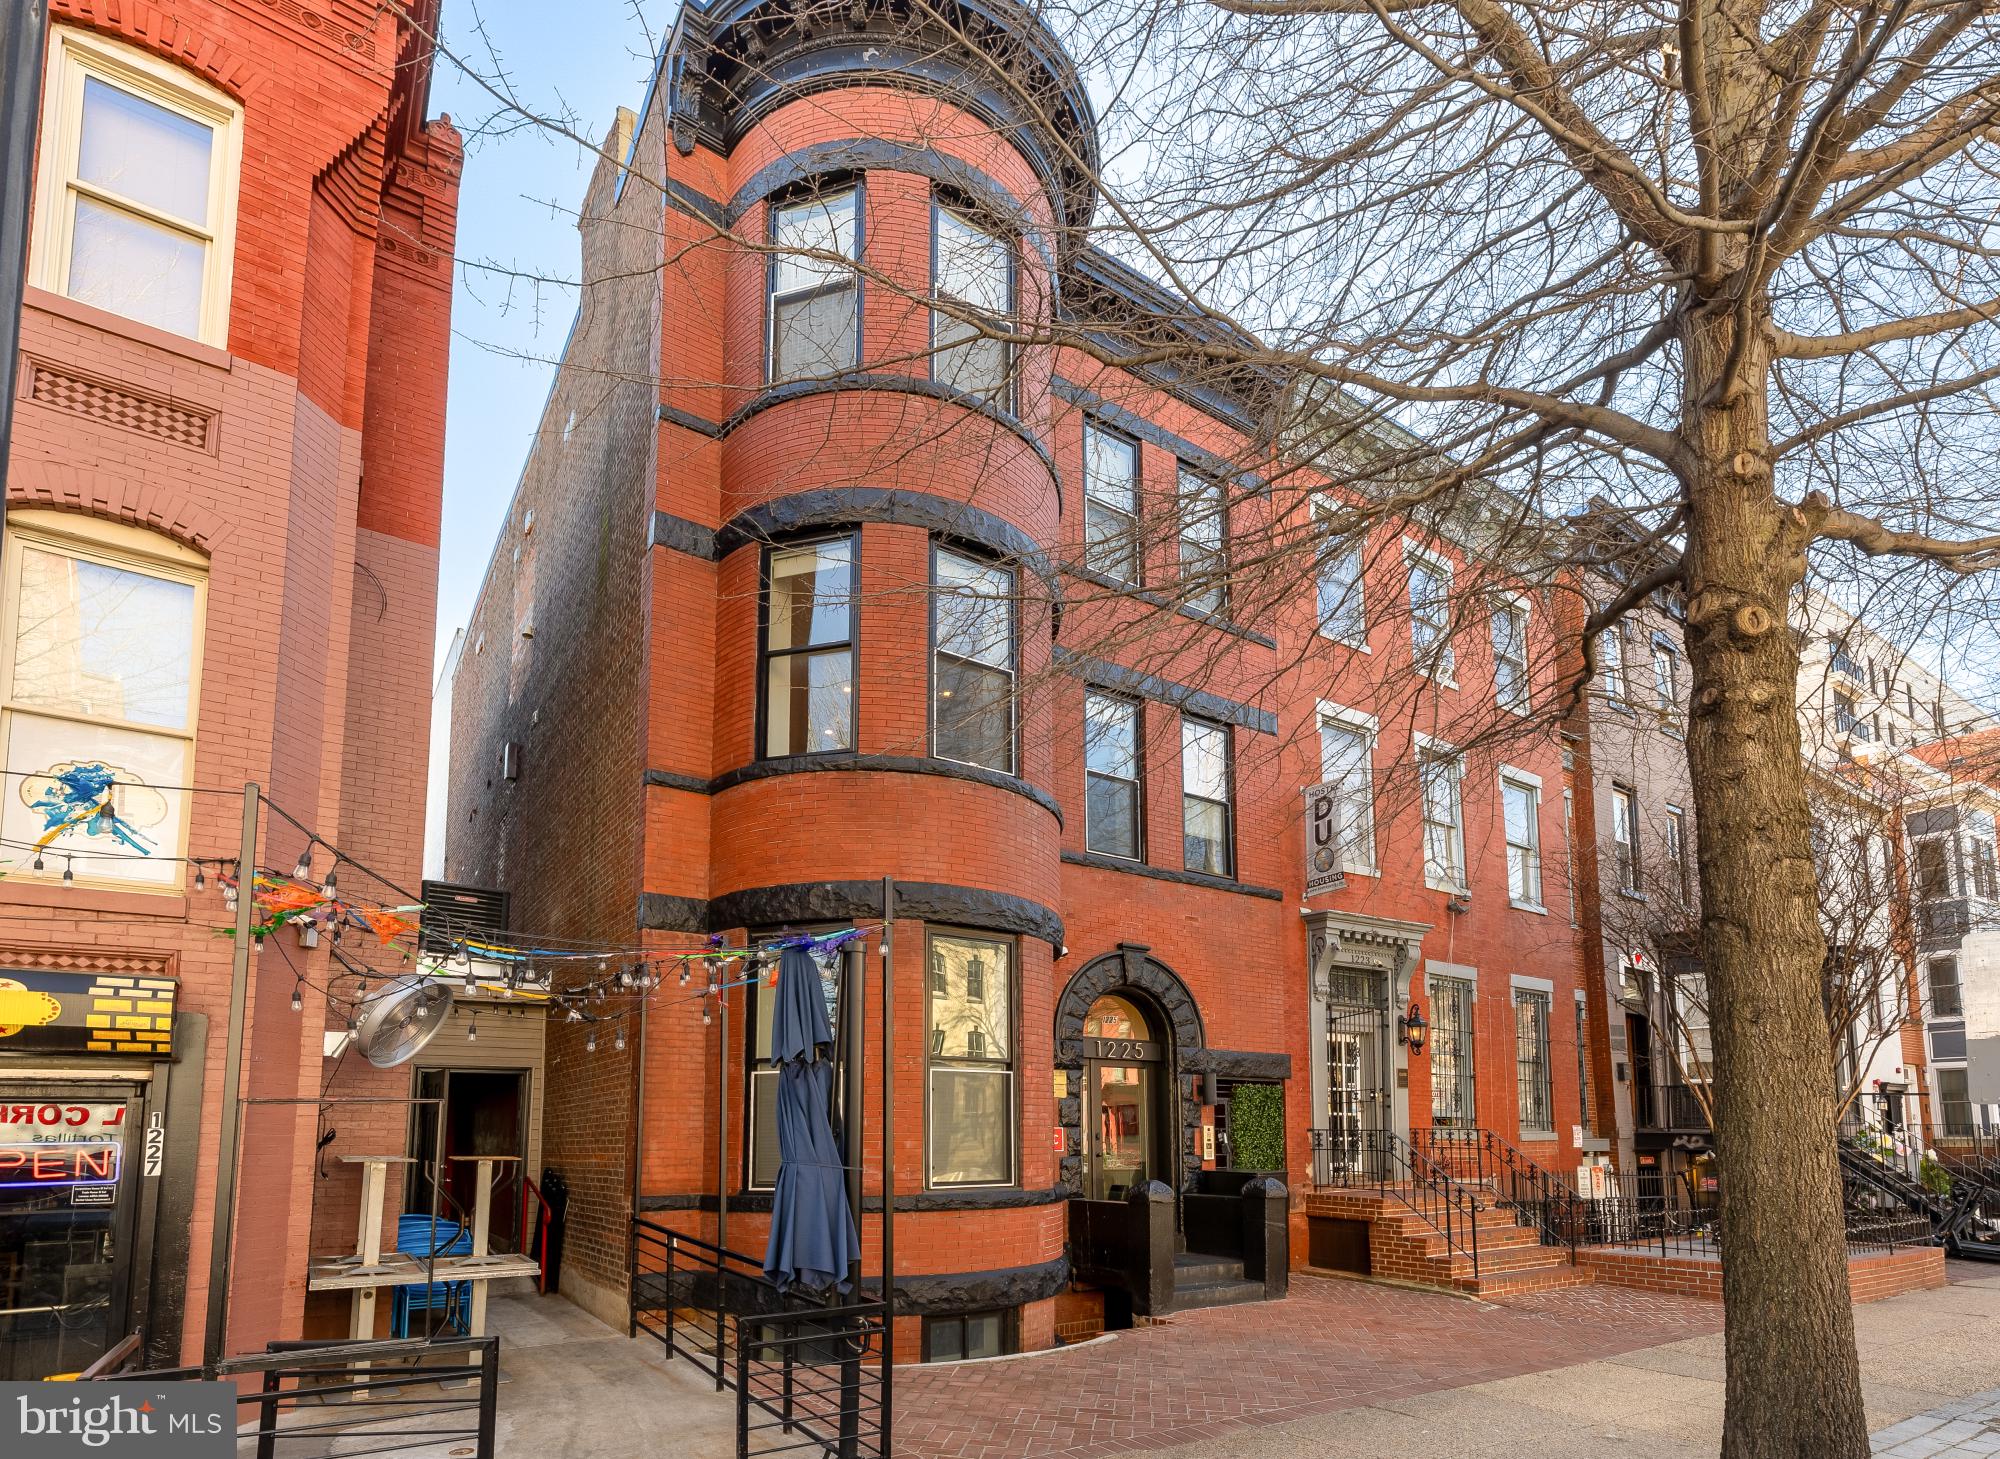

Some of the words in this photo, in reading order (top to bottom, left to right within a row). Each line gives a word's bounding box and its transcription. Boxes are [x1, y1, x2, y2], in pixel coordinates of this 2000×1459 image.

[1308, 872, 1343, 887] HOUSING
[1351, 955, 1370, 965] 1223
[1102, 1015, 1118, 1024] 1225
[1096, 1040, 1144, 1059] 1225
[146, 1112, 163, 1176] 1227
